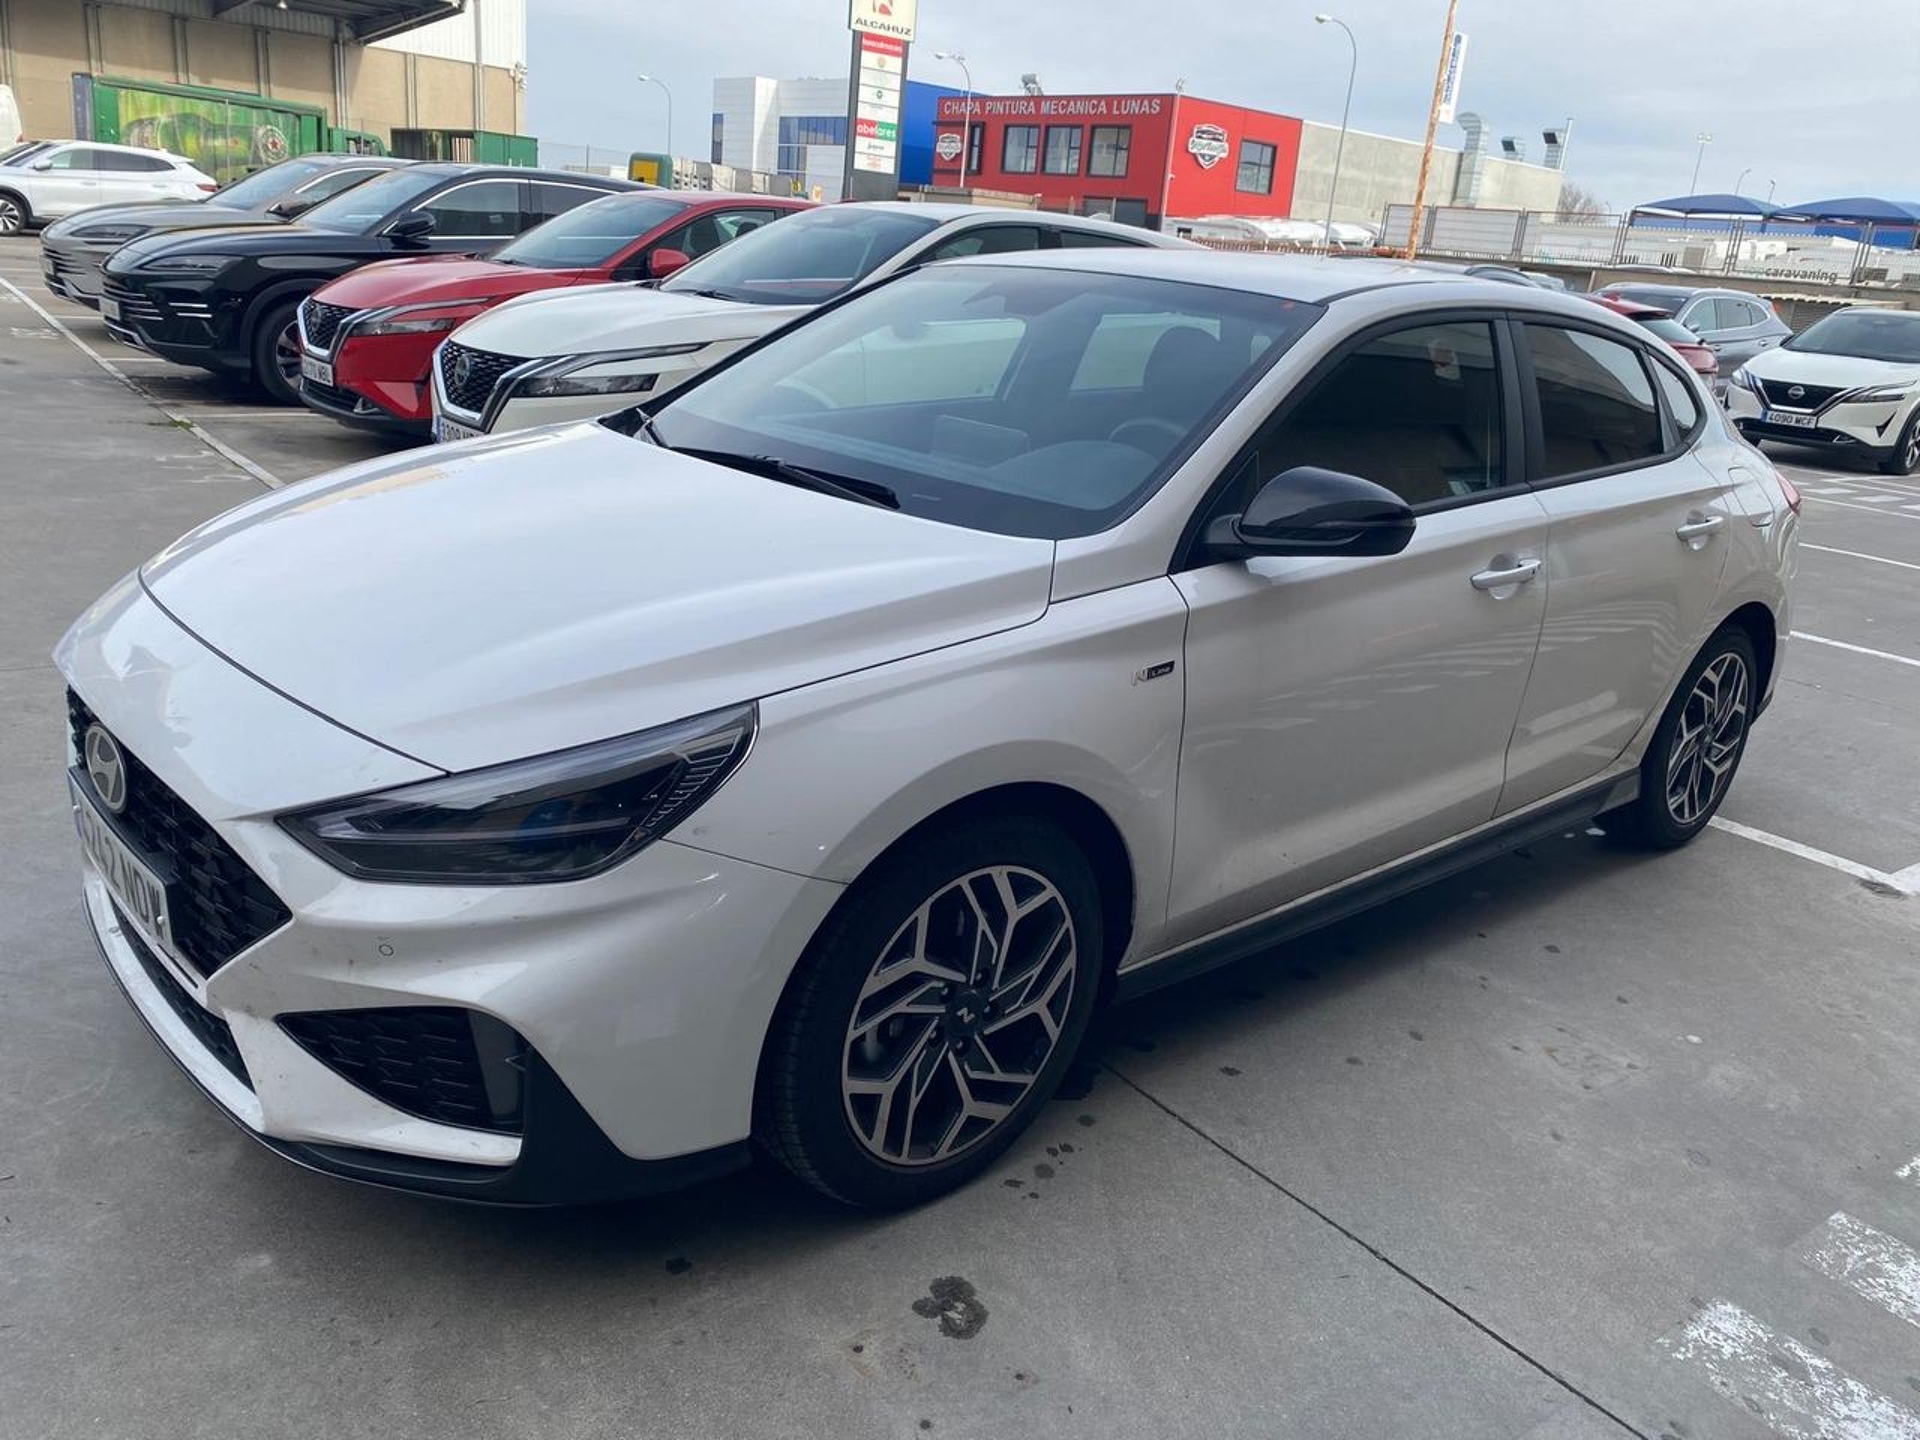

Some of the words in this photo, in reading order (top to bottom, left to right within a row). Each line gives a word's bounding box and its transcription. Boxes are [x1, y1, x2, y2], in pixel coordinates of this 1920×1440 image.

[855, 17, 912, 36] ALCAHUZ
[944, 101, 981, 114] CHAPA
[985, 101, 1036, 114] PINTURA
[1040, 100, 1107, 114] MECANICA
[1113, 98, 1161, 114] LUNAS
[1765, 267, 1838, 284] caravaning
